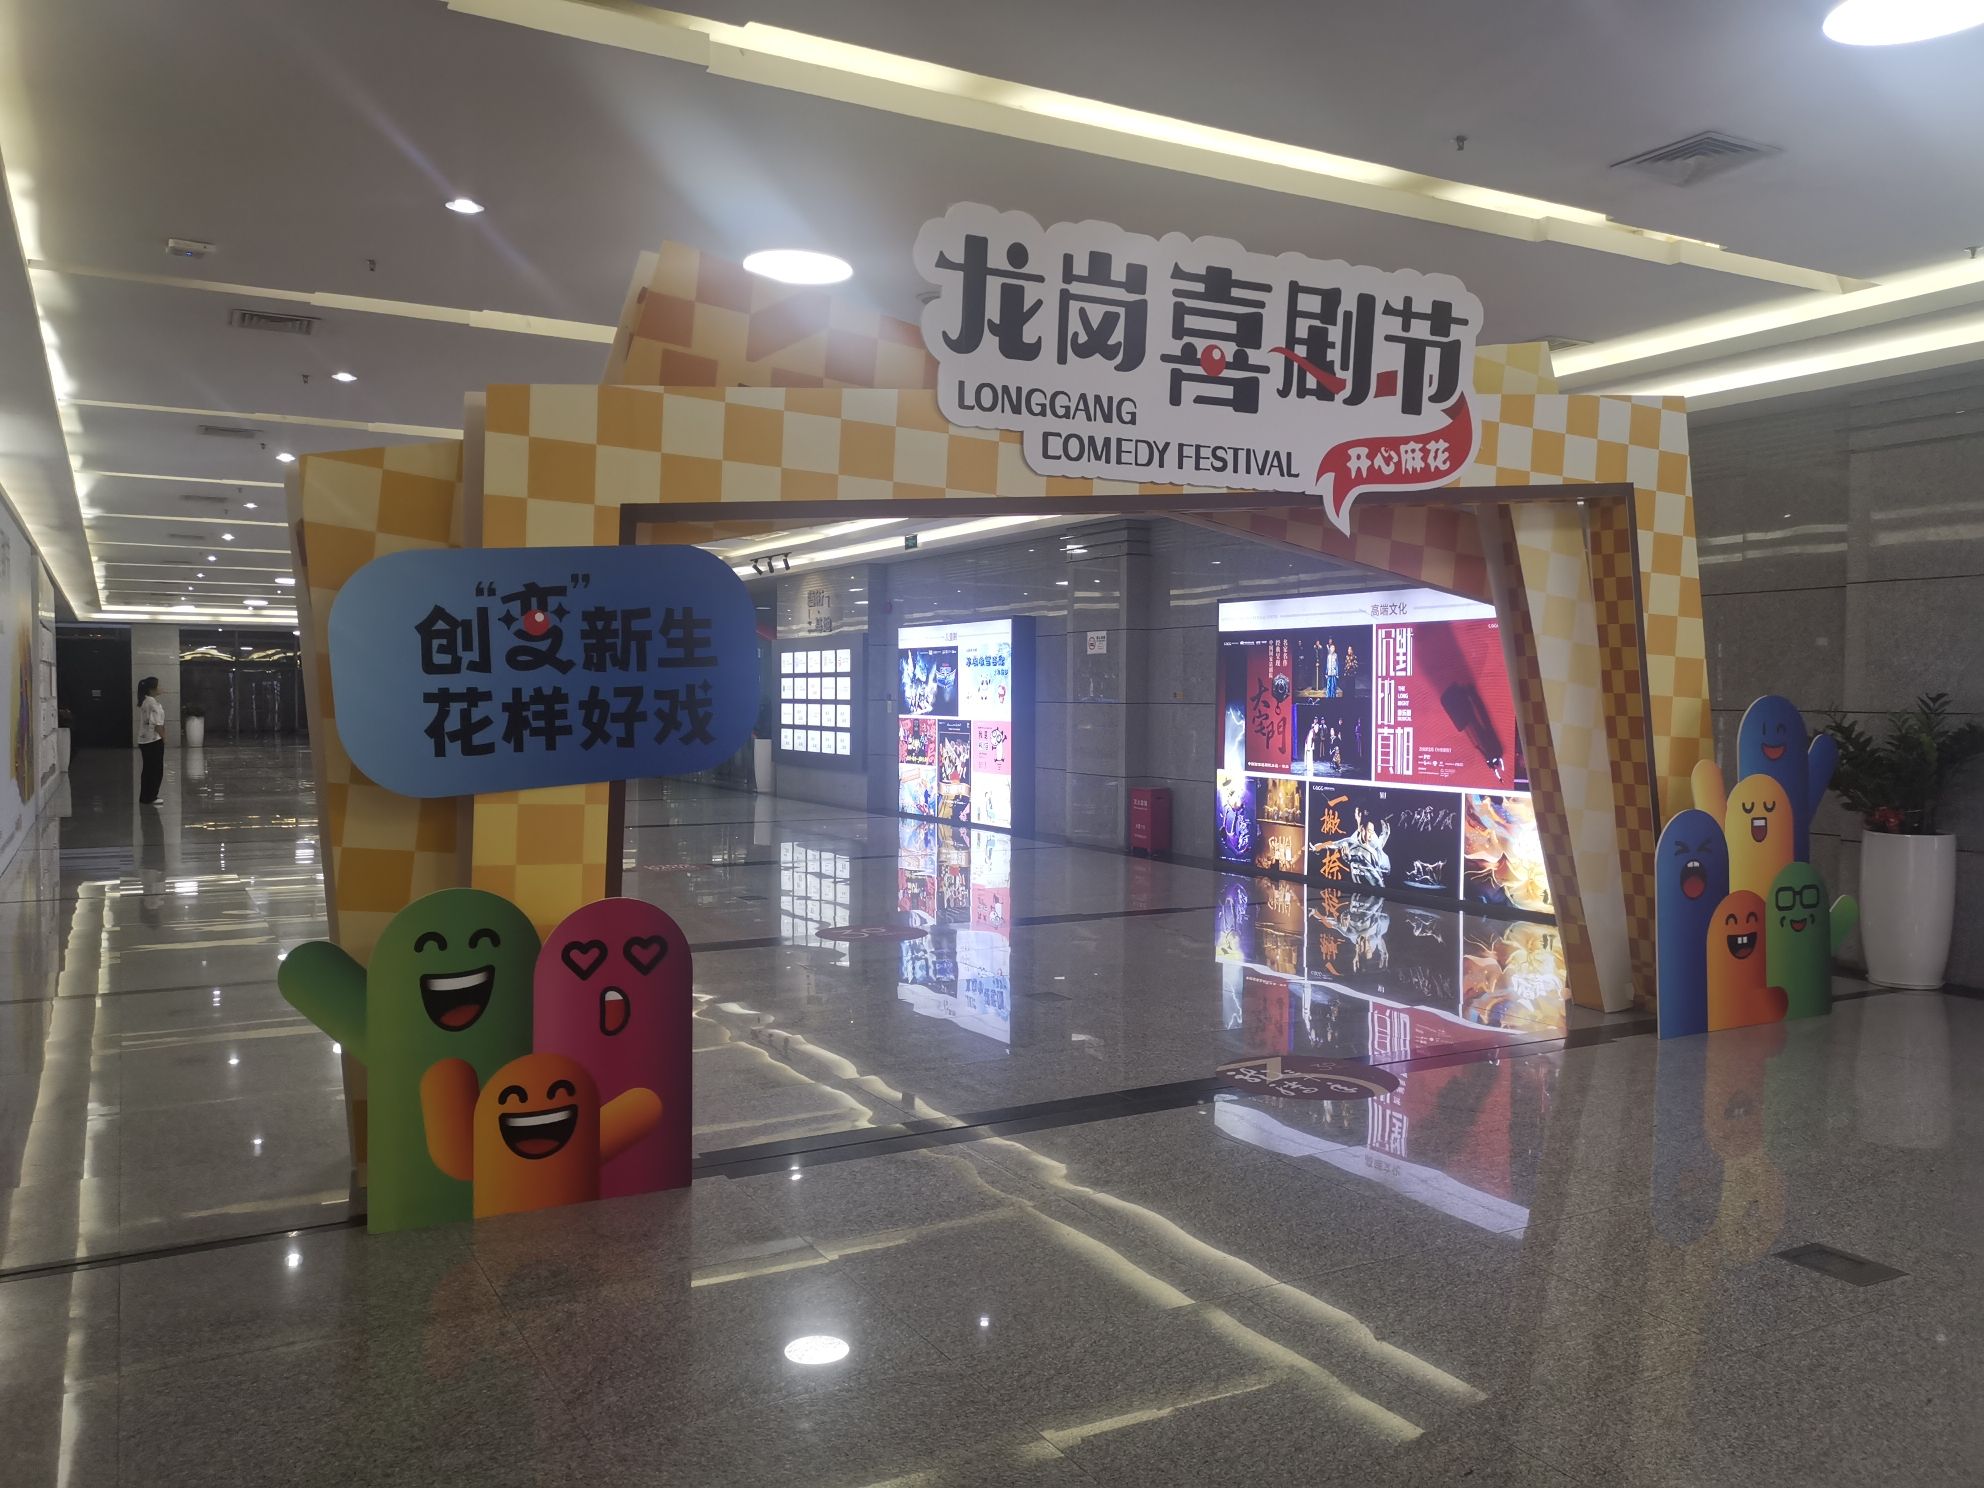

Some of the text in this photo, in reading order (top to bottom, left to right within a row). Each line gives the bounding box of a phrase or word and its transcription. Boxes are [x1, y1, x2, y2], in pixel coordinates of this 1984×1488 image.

[934, 233, 1470, 417] 龙岗喜剧节
[957, 379, 1138, 426] LONGGANG
[1041, 431, 1301, 479] COMEDY FESTIVAL
[1346, 438, 1451, 480] 开心麻花
[1370, 602, 1408, 617] 高端文化
[422, 686, 717, 758] 花样好戏
